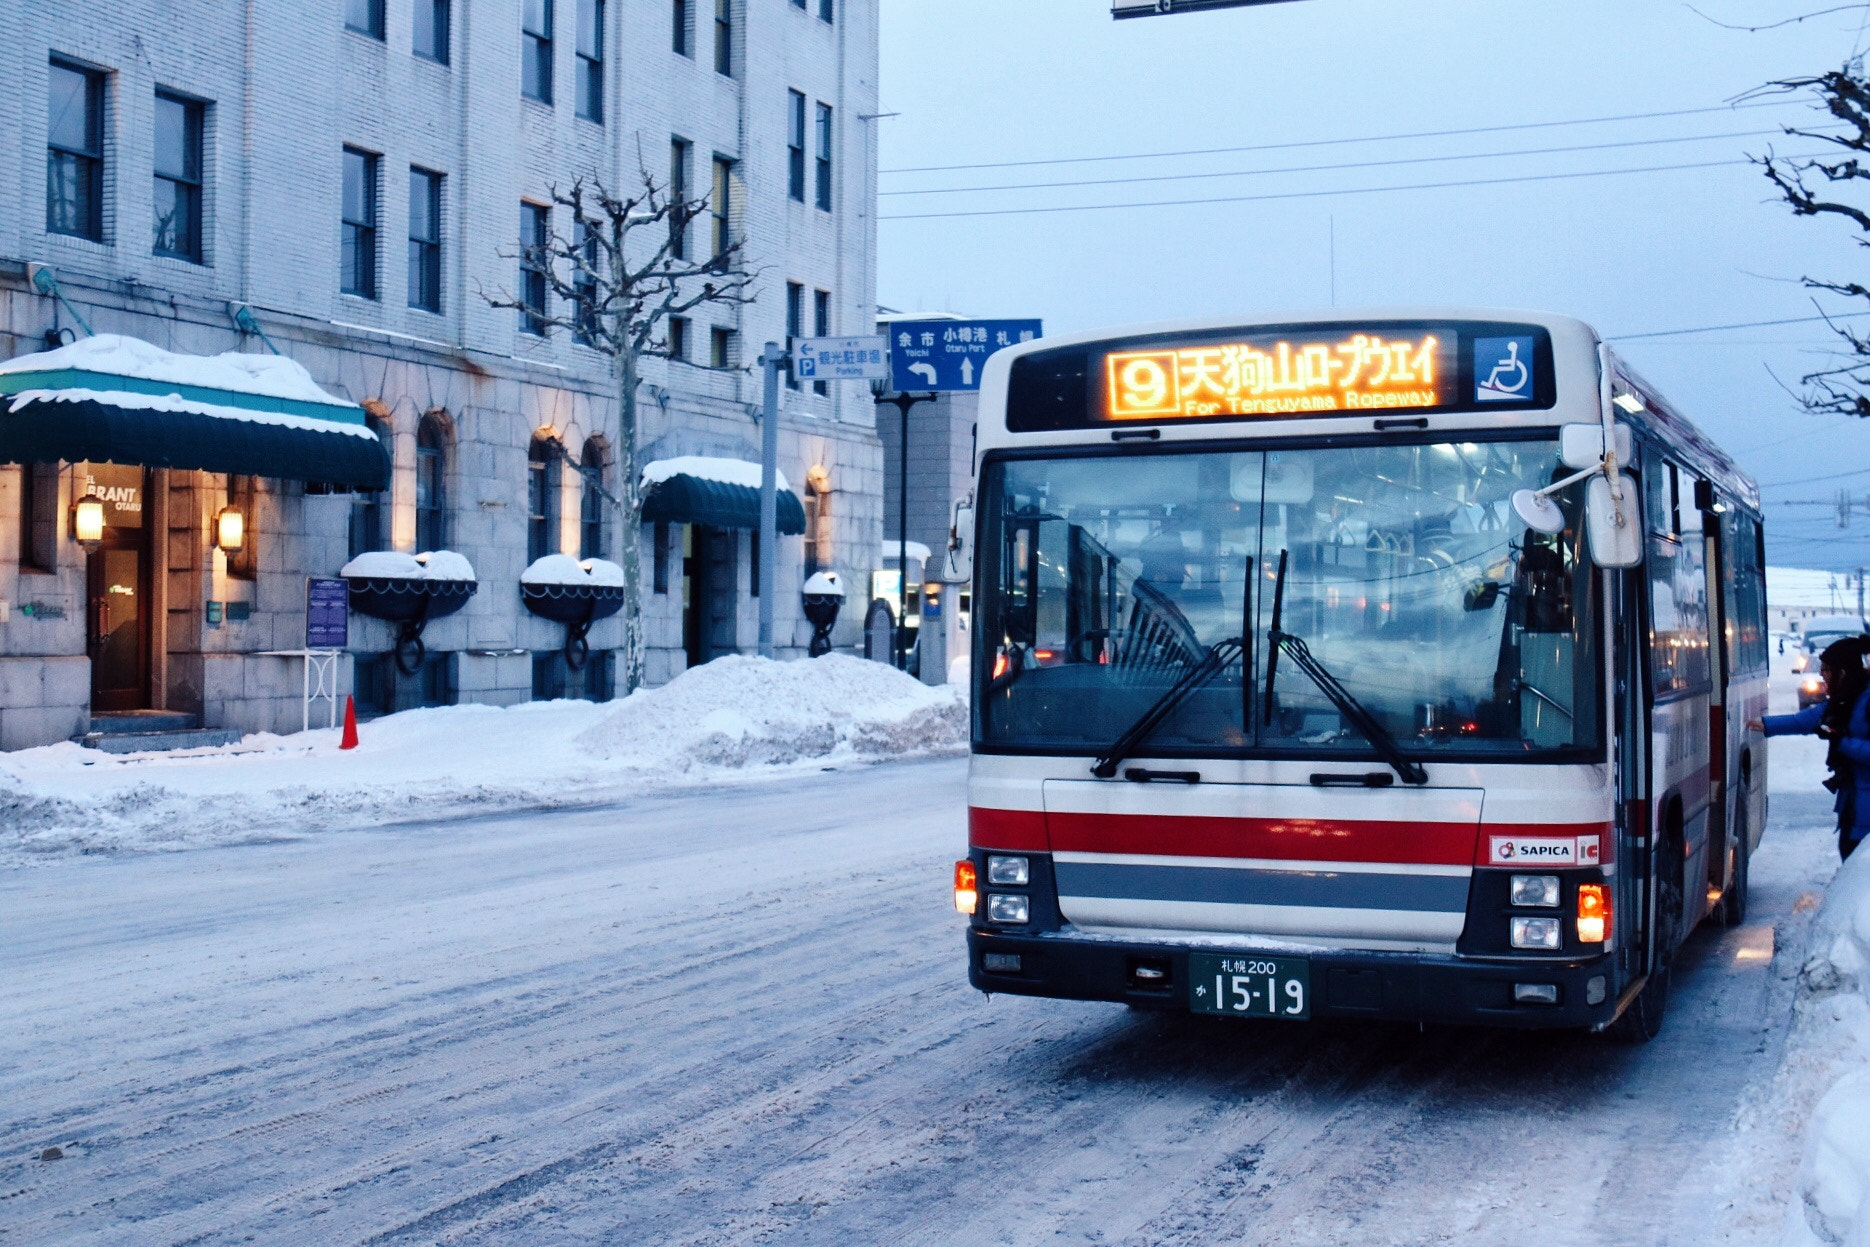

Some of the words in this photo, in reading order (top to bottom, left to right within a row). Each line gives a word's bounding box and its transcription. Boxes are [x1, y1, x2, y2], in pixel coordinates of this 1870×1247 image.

[899, 332, 934, 346] 余市
[943, 327, 987, 342] 小樽港
[905, 349, 929, 357] Yoichi
[945, 344, 966, 353] Otaru
[968, 344, 985, 353] Port
[836, 367, 863, 375] Parking
[1122, 359, 1166, 407] 9
[1185, 400, 1221, 415] For
[1225, 394, 1336, 413] Tenguyama
[1345, 389, 1435, 408] Ropeway
[115, 502, 142, 511] OTARU
[1520, 845, 1570, 856] SAPICA
[1216, 975, 1304, 1015] 15-19
